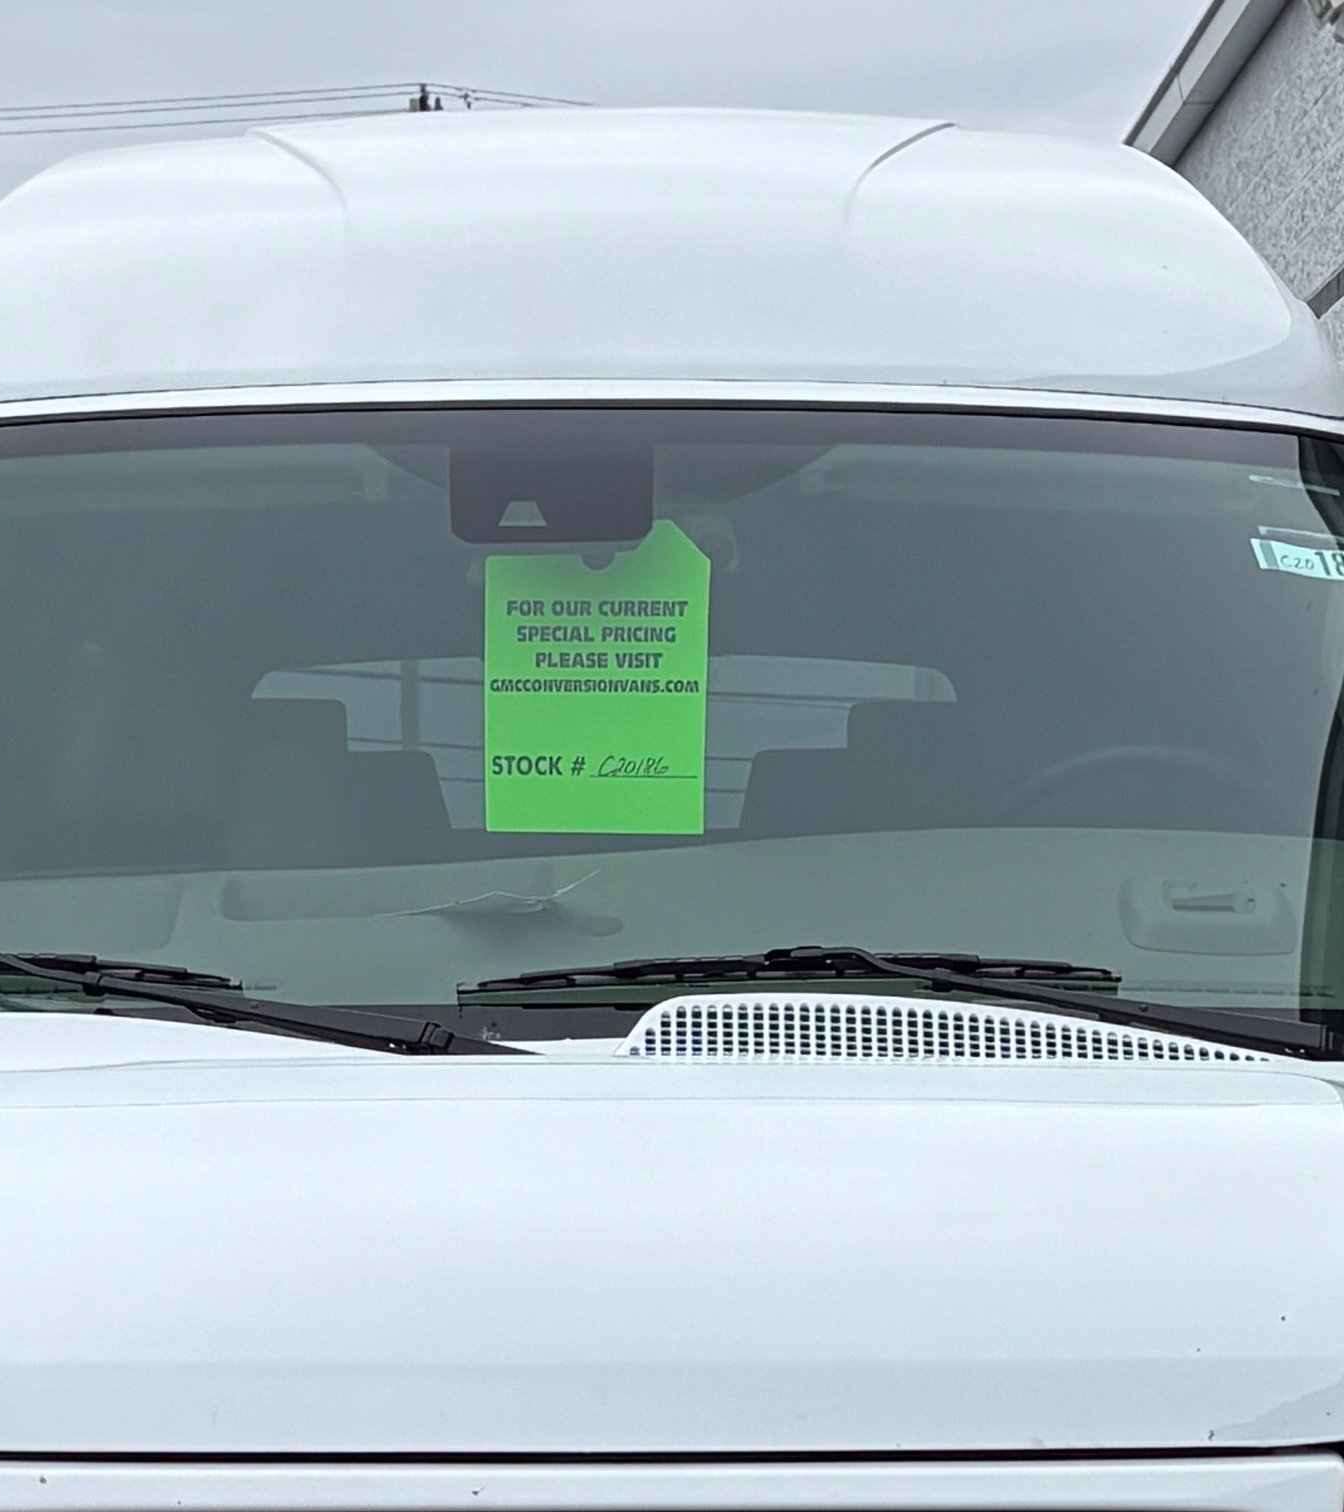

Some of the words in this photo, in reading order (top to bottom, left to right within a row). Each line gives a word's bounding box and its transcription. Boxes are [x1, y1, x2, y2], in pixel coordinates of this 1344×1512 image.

[506, 600, 545, 617] FOR
[551, 600, 592, 617] OUR
[598, 600, 688, 617] CURRENT
[517, 626, 595, 643] SPECIAL
[601, 626, 677, 643] PRICING
[535, 652, 609, 669] PLEASE
[616, 652, 664, 669] VISIT
[490, 678, 700, 694] GMCCONVERSIONVANS.COM
[492, 755, 563, 776] STOCK
[570, 755, 586, 777] #
